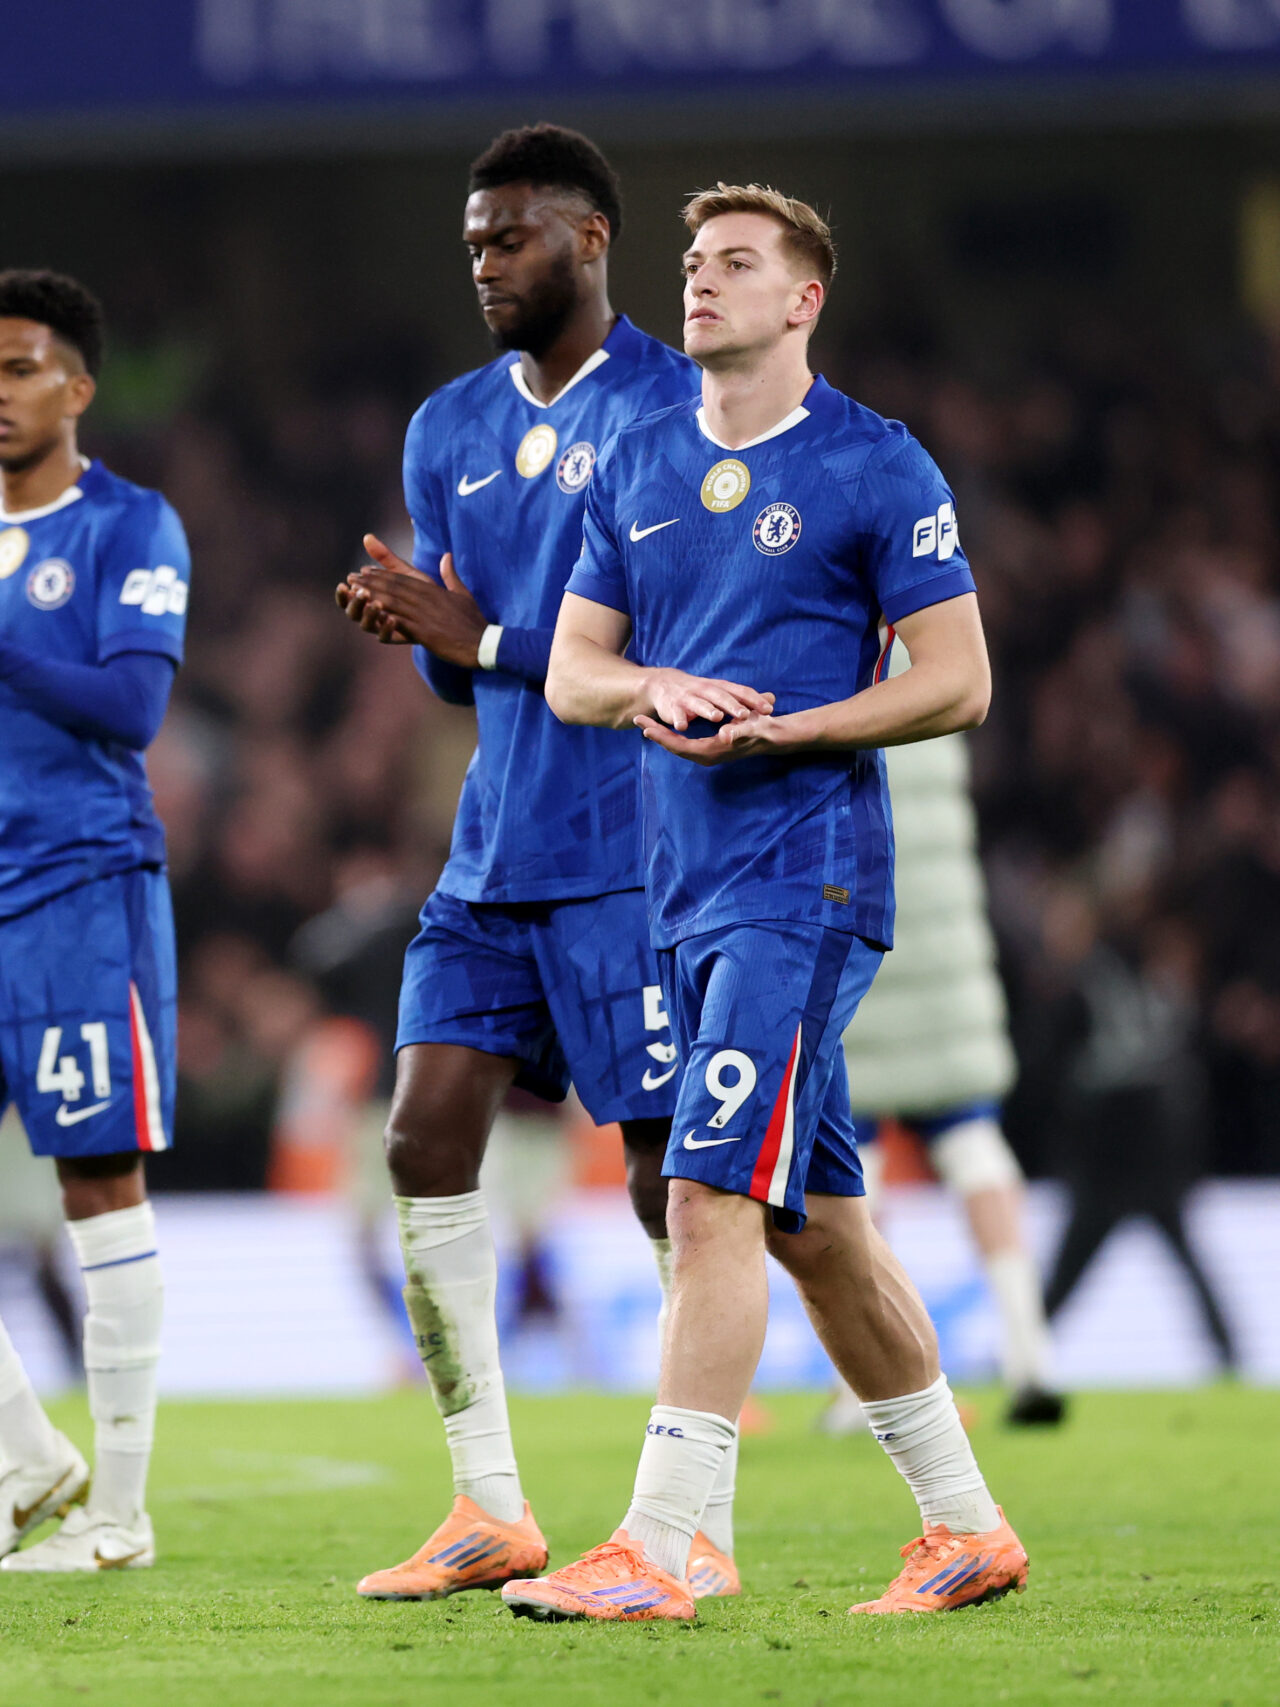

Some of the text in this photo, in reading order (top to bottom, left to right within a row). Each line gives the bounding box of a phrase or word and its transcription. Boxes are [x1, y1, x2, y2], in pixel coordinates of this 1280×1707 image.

[705, 463, 747, 493] WORLD CHAMPIONS
[711, 500, 731, 508] FIFA
[765, 503, 797, 518] CHELSEA
[642, 984, 677, 1064] 5
[36, 1021, 112, 1102] 41
[705, 1049, 757, 1129] 9
[646, 1423, 684, 1439] CFC
